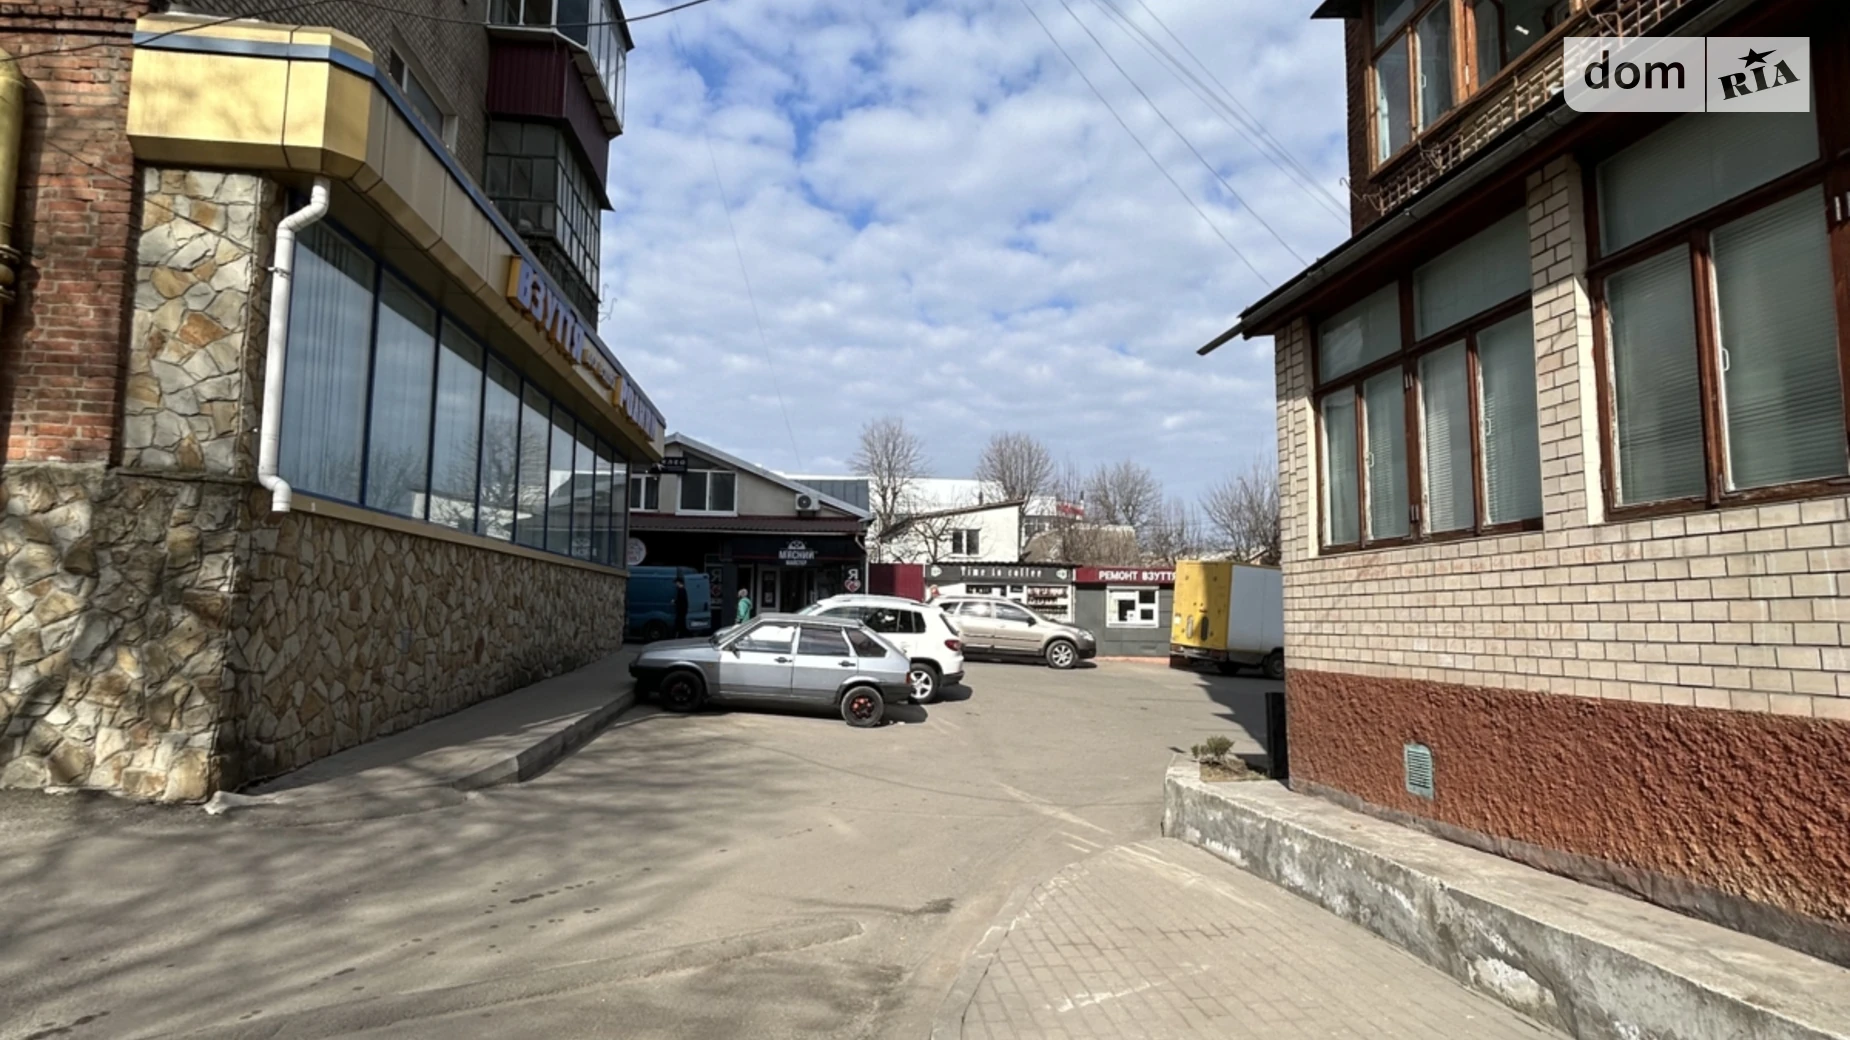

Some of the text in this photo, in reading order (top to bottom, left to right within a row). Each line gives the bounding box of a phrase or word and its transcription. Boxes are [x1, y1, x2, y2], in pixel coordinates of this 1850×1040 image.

[516, 258, 585, 364] ВЗУТТЯ
[848, 568, 859, 580] Я
[960, 566, 985, 577] Time
[1099, 570, 1138, 581] РЕМОНТ
